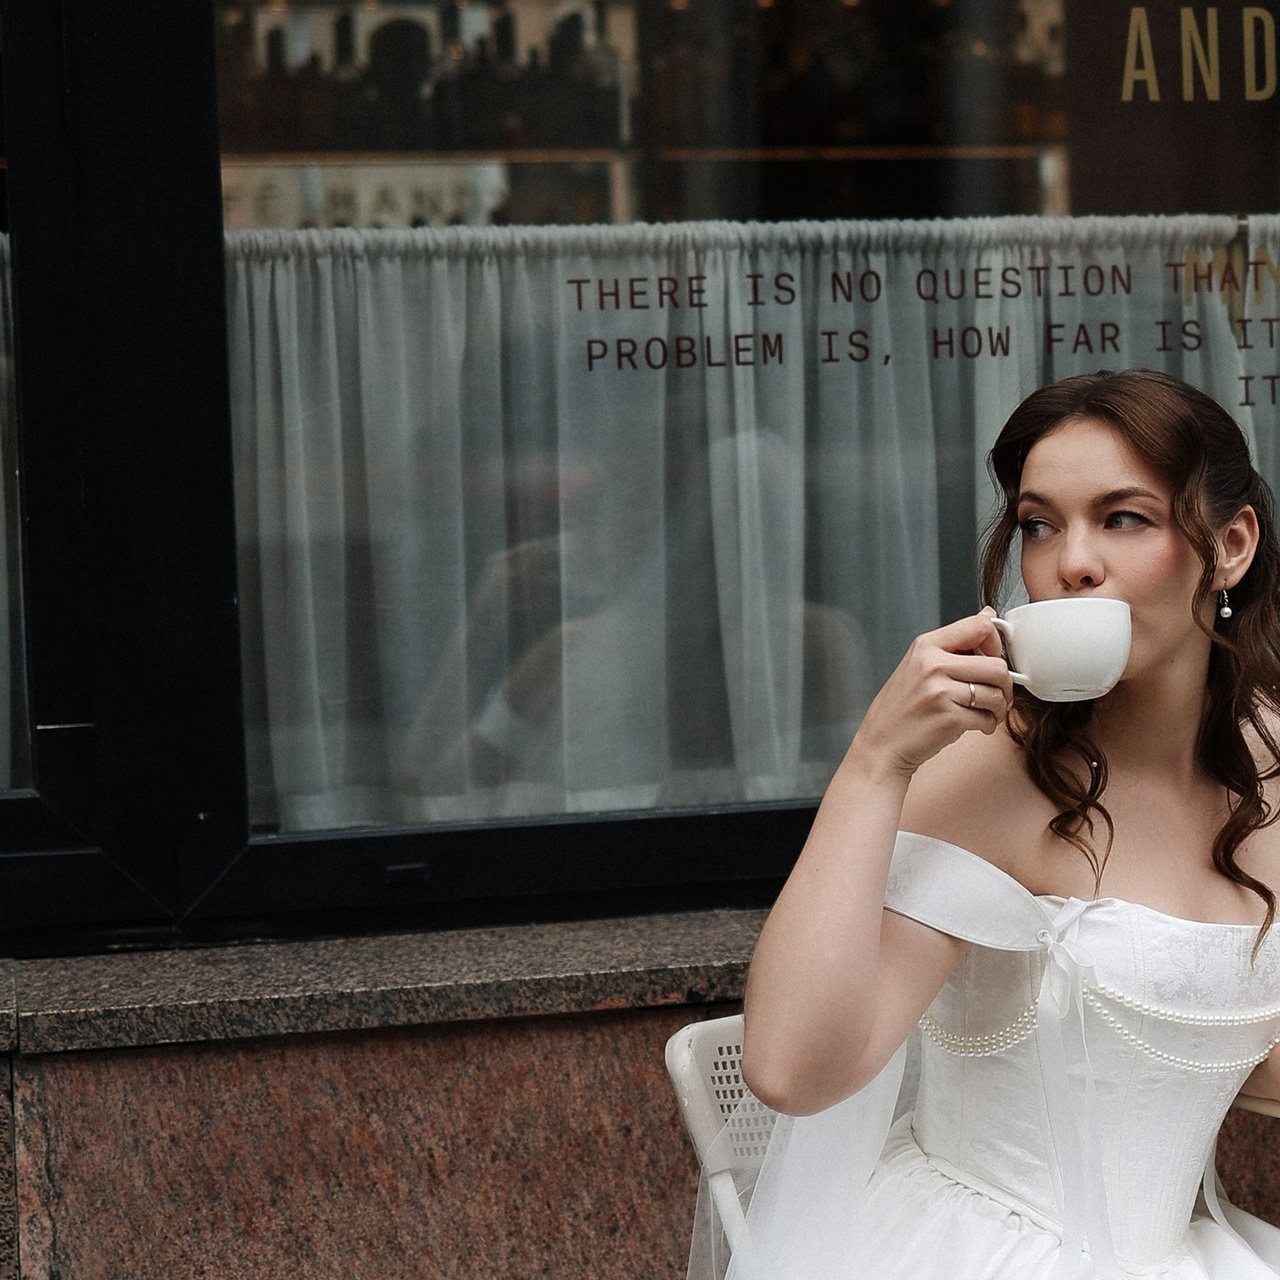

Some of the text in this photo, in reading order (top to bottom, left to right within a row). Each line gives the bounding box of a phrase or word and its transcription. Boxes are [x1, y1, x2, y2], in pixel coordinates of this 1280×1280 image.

[1121, 6, 1277, 103] AND
[566, 275, 709, 311] THERE
[746, 272, 796, 306] IS
[831, 270, 882, 304] NO
[916, 264, 1133, 305] QUESTION
[1165, 260, 1267, 293] THAT
[586, 332, 784, 371] PROBLEM
[821, 330, 892, 366] IS,
[932, 326, 1010, 359] HOW
[1046, 323, 1120, 354] FAR
[1154, 320, 1202, 352] IS
